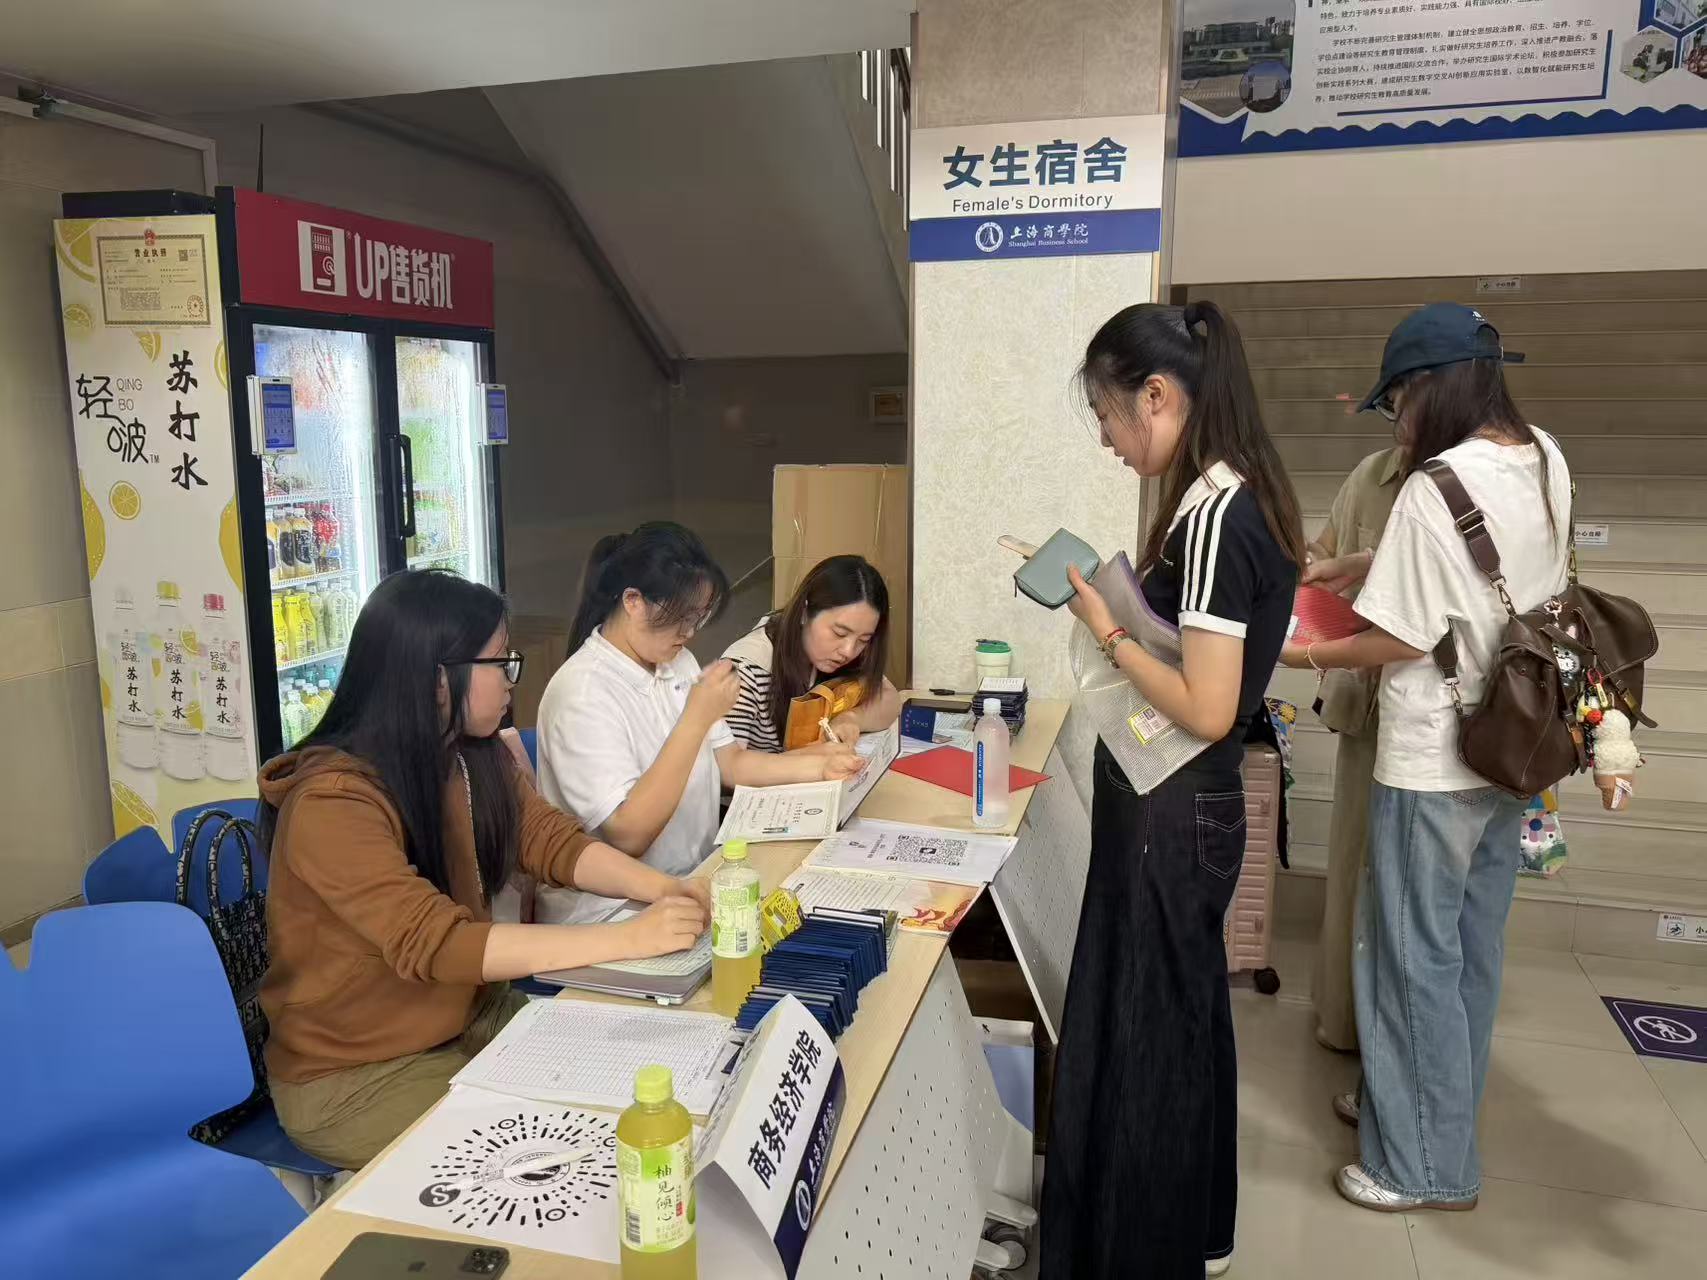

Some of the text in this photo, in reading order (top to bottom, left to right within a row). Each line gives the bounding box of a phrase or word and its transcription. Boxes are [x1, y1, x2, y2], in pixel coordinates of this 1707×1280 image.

[942, 136, 1127, 190] 女生宿舍
[952, 192, 1113, 213] Female's Dormitory
[1008, 240, 1037, 248] Shanghai
[353, 232, 454, 310] UP售货机
[116, 378, 143, 392] QING
[118, 399, 134, 411] BO
[166, 350, 209, 490] 苏打水
[126, 666, 141, 713] 苏打水
[170, 669, 186, 720] 苏打水
[215, 676, 230, 724] 苏打水
[748, 1029, 822, 1190] 商务经济学院
